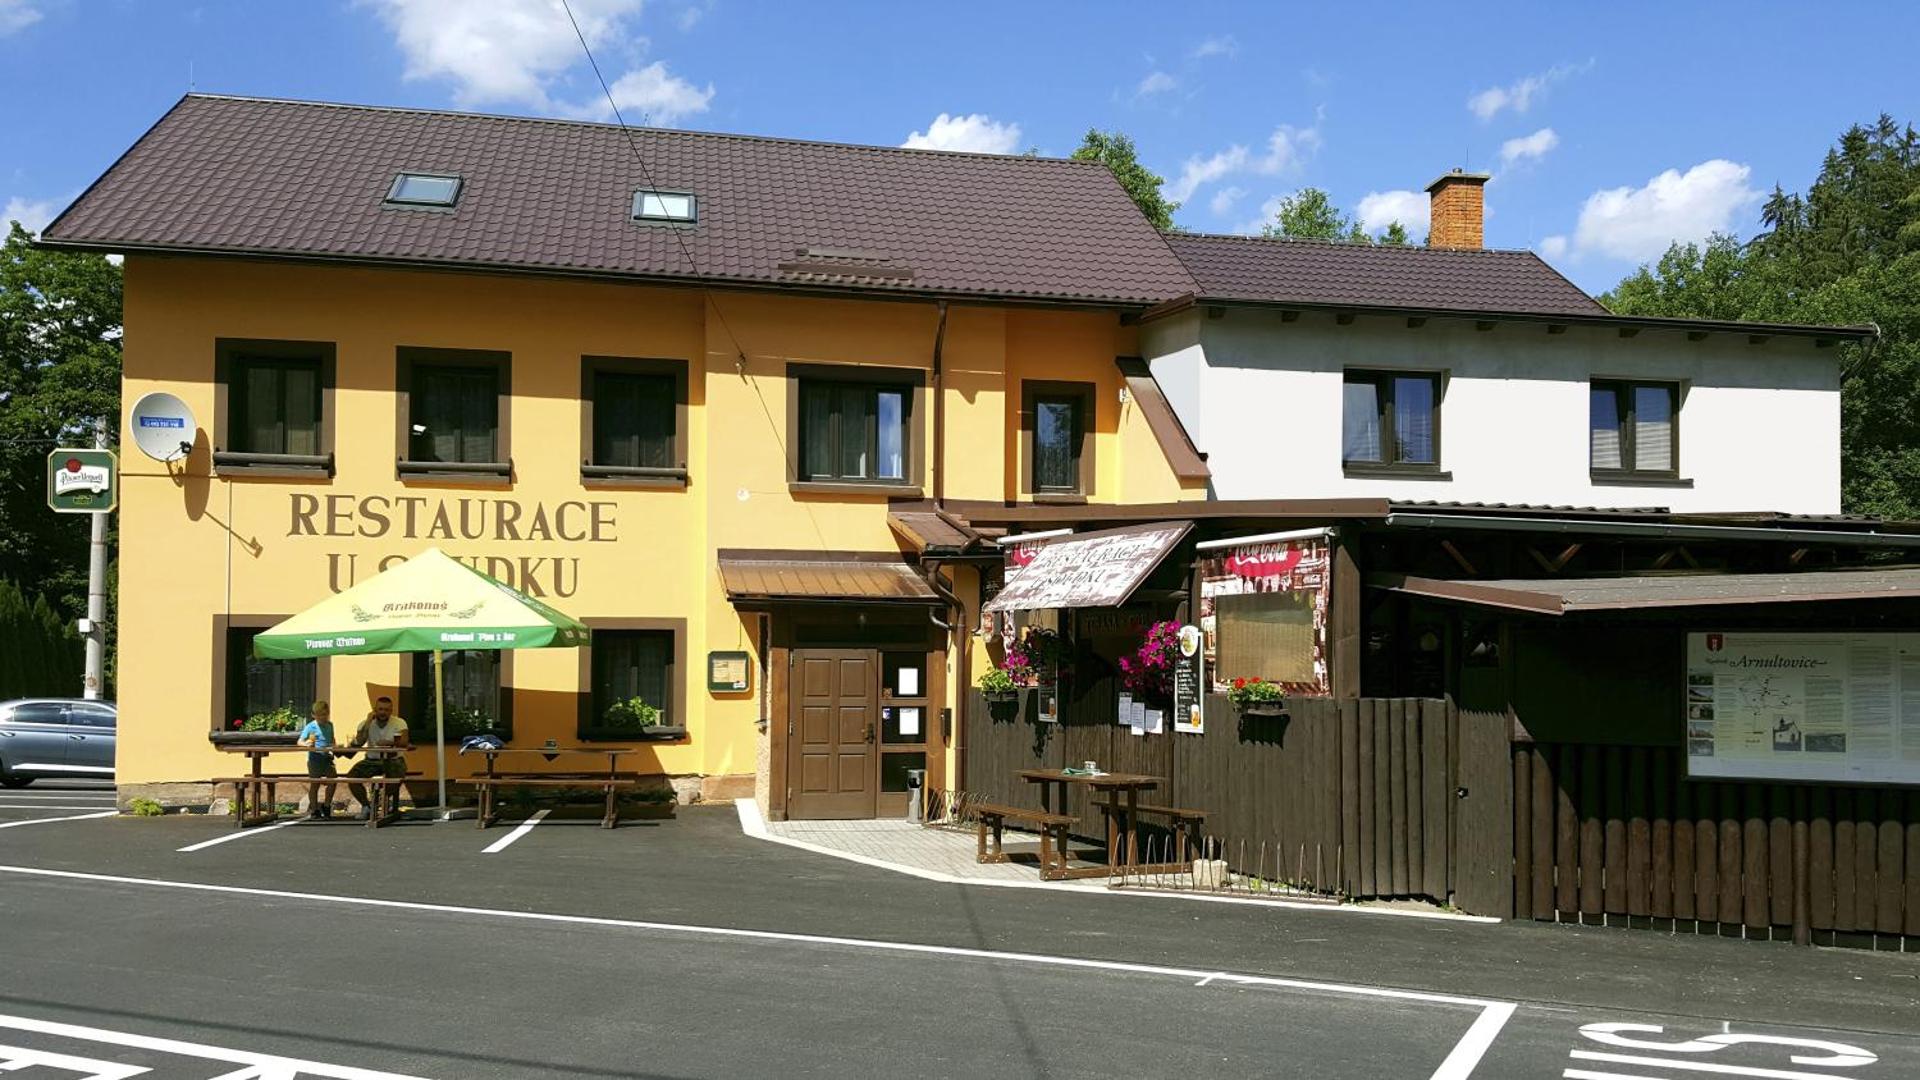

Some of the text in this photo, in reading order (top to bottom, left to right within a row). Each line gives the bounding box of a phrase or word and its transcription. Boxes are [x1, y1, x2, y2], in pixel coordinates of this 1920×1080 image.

[286, 493, 618, 542] RESTAURACE
[327, 553, 357, 595] U
[1735, 654, 1817, 668] Arnultovice
